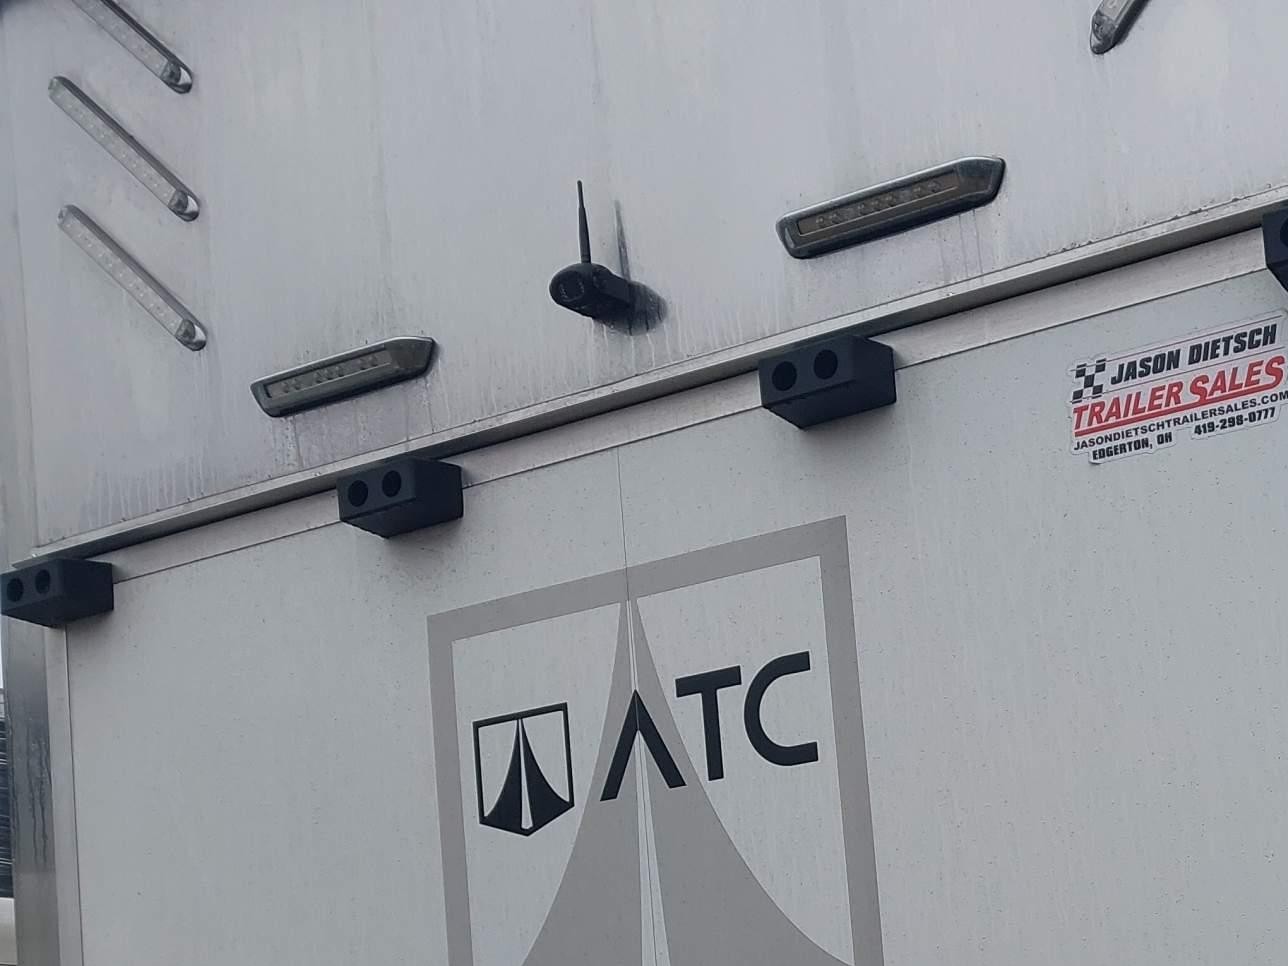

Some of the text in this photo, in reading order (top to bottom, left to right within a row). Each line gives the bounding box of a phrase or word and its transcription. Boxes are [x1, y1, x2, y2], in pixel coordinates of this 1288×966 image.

[1111, 323, 1278, 386] JASON DIETSCH
[1072, 355, 1286, 430] TRAILER SALES
[1092, 406, 1276, 461] EDGERTON, OH 419-298-0777
[600, 650, 819, 801] ATC
